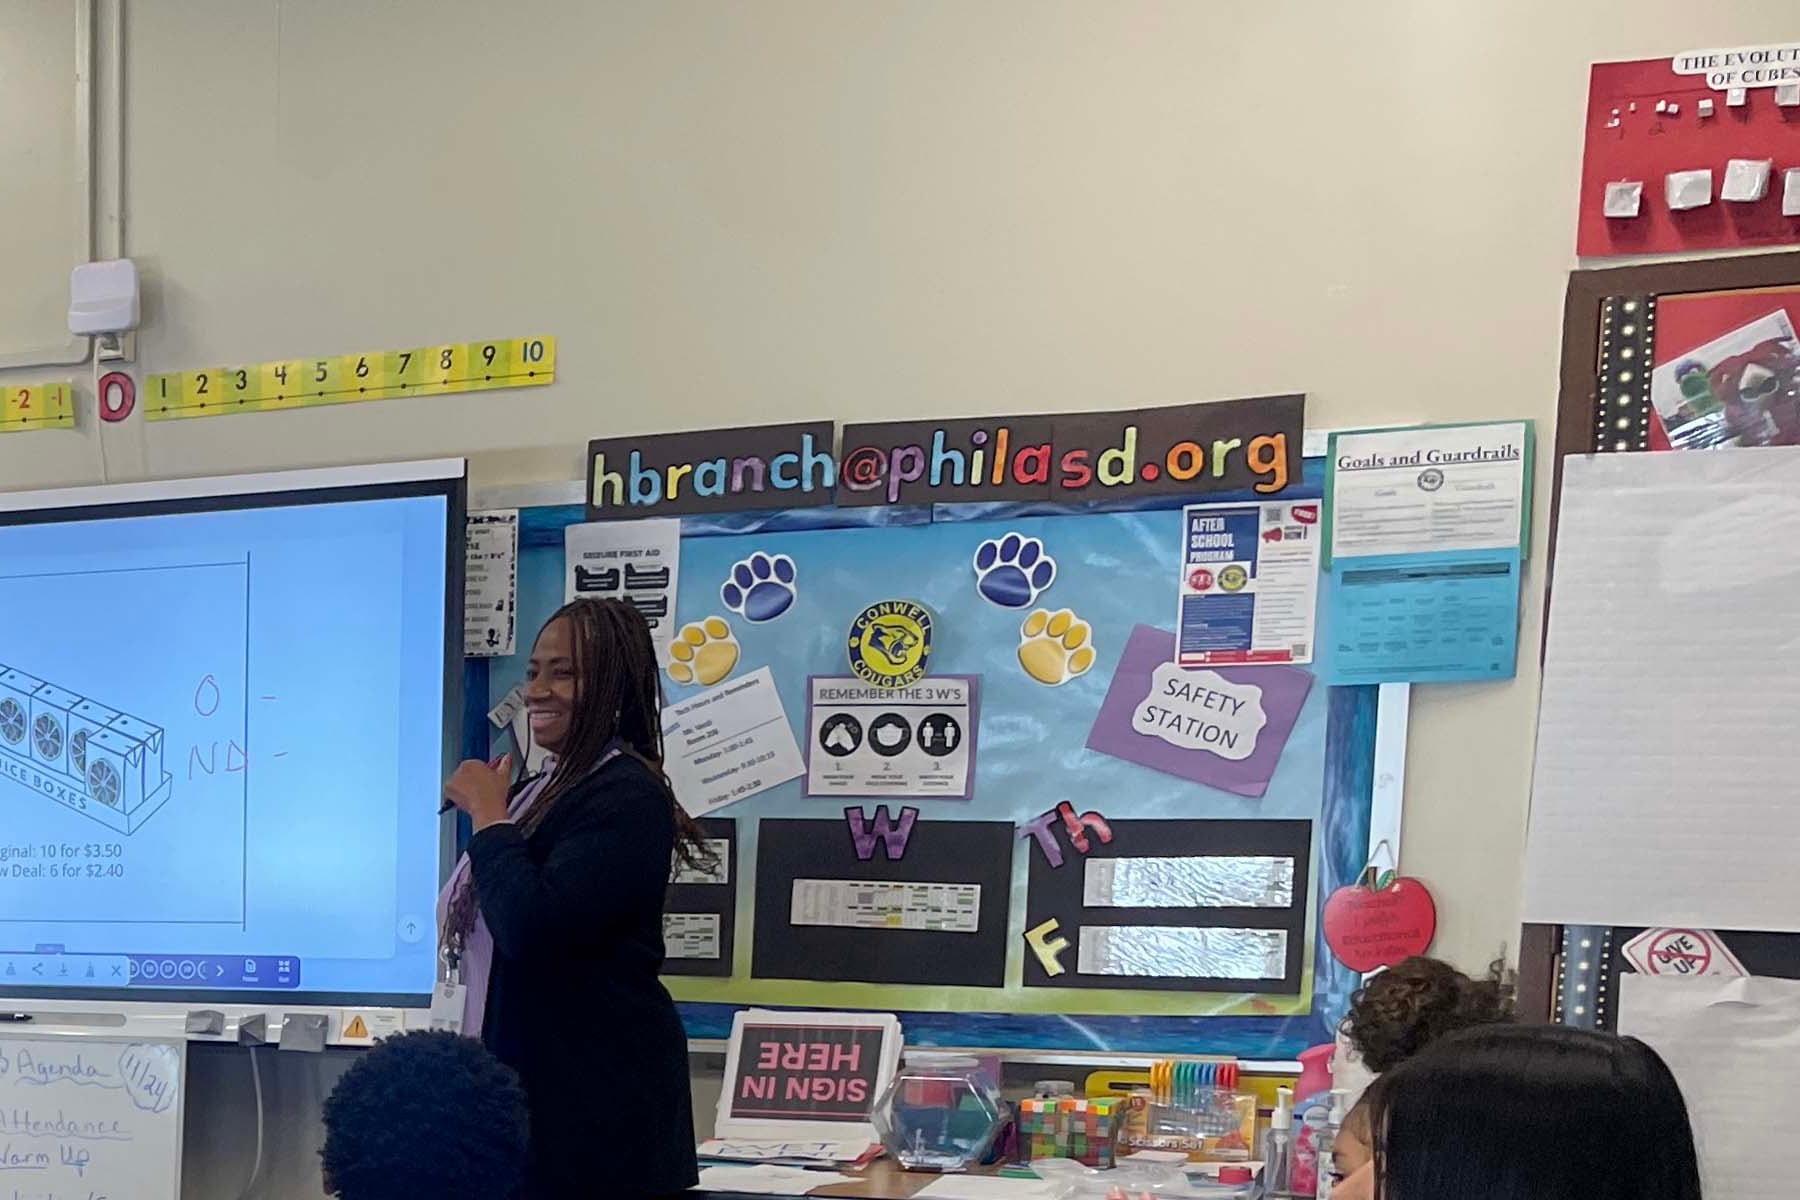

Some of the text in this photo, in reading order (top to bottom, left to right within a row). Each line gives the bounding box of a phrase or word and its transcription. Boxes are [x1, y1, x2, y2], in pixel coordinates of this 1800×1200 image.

[1681, 55, 1719, 70] THE
[1712, 72, 1737, 85] OF
[11, 389, 30, 409] -2
[51, 386, 63, 407] -1
[99, 371, 136, 422] 0
[160, 377, 168, 398] 1
[196, 374, 209, 394] 2
[236, 369, 248, 391] 3
[274, 365, 287, 385] 4
[315, 361, 328, 382] 5
[356, 356, 369, 378] 6
[398, 353, 412, 374] 7
[439, 348, 453, 370] 8
[482, 345, 496, 366] 9
[521, 341, 544, 363] 10
[592, 426, 1288, 507] hbranch@philasd.org
[1337, 444, 1520, 470] Goals and Guardrails
[1192, 517, 1225, 532] AFTER
[620, 550, 642, 558] FIRST
[645, 549, 660, 557] AID
[1190, 550, 1235, 562] PROGRAM
[1191, 533, 1235, 548] SCHOOL
[856, 602, 931, 635] CONWELL
[854, 659, 925, 688] COUGARS
[819, 688, 961, 700] REMEMBER THE 3 W'S
[1163, 678, 1246, 717] SAFETY
[1142, 705, 1239, 749] STATION
[188, 740, 249, 780] ND
[32, 774, 88, 810] BOXES
[844, 805, 919, 860] W
[1014, 801, 1113, 869] Th
[40, 844, 57, 857] 10
[60, 843, 81, 857] for
[83, 842, 122, 859] $3.50
[10, 863, 48, 878] Deal:
[49, 864, 59, 877] 6
[61, 863, 82, 878] for
[83, 863, 124, 879] $2.40
[1024, 918, 1070, 977] F
[757, 1041, 862, 1072] HERE
[16, 1048, 111, 1081] Agenda
[124, 1054, 169, 1103] 11/24
[742, 1075, 869, 1102] SIGN IN
[60, 1144, 91, 1178] Up
